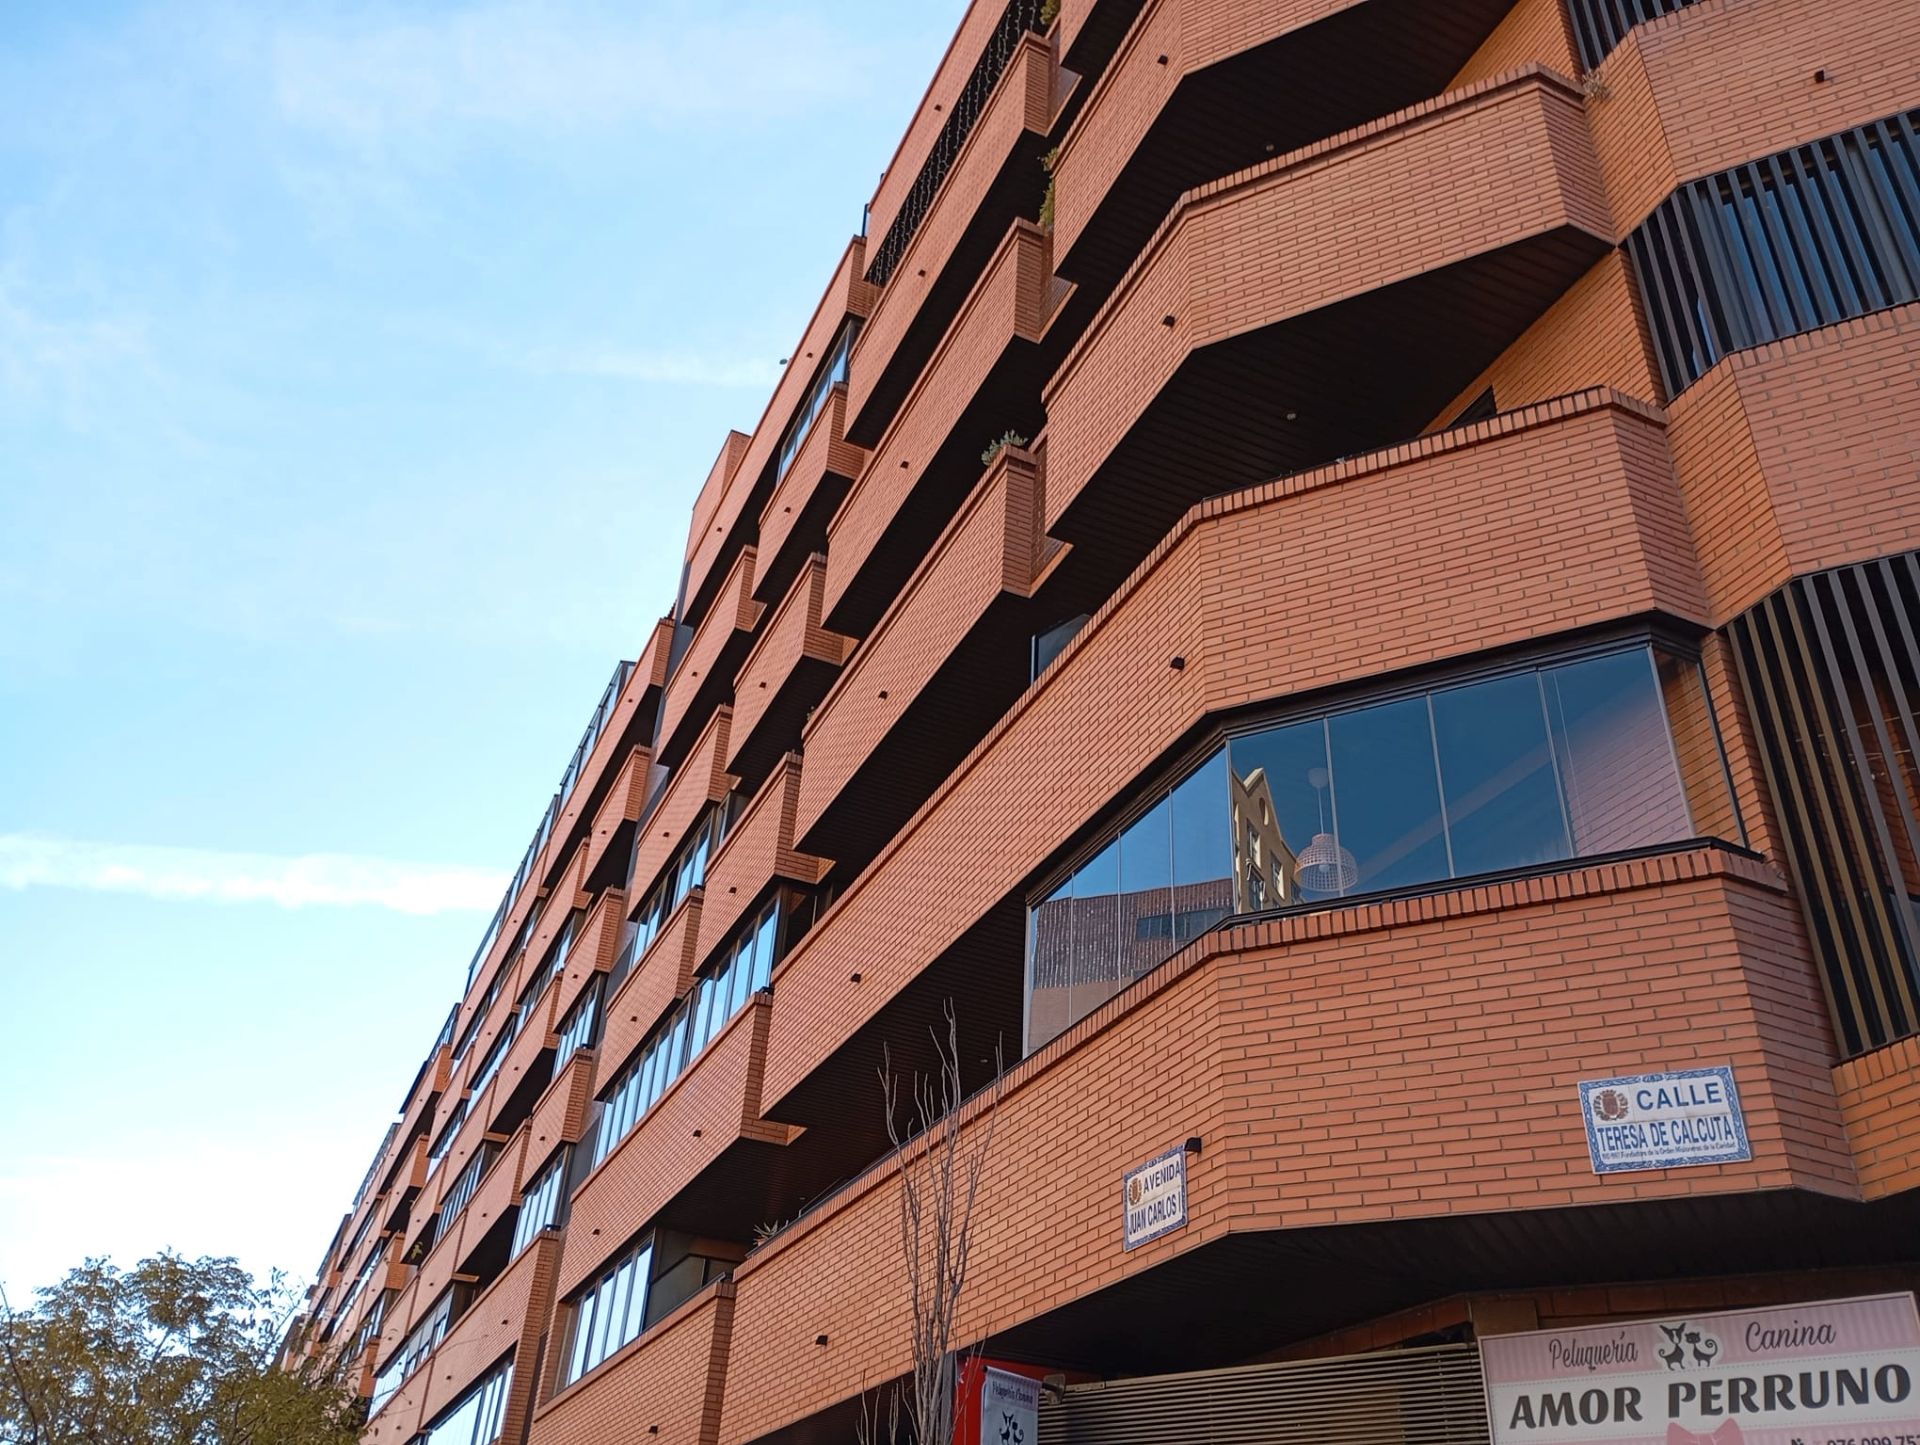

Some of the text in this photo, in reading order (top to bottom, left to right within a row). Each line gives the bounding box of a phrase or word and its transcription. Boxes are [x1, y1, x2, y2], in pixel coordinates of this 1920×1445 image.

[1636, 1082, 1722, 1111] CALLE
[1597, 1116, 1734, 1152] TERESA DE CALCUTA
[1143, 1161, 1180, 1194] AVENIDA
[1129, 1191, 1181, 1235] JUAN CARLOS I
[1549, 1320, 1836, 1372] Peluquería Canina
[1509, 1364, 1911, 1429] AMOR PERRUNO
